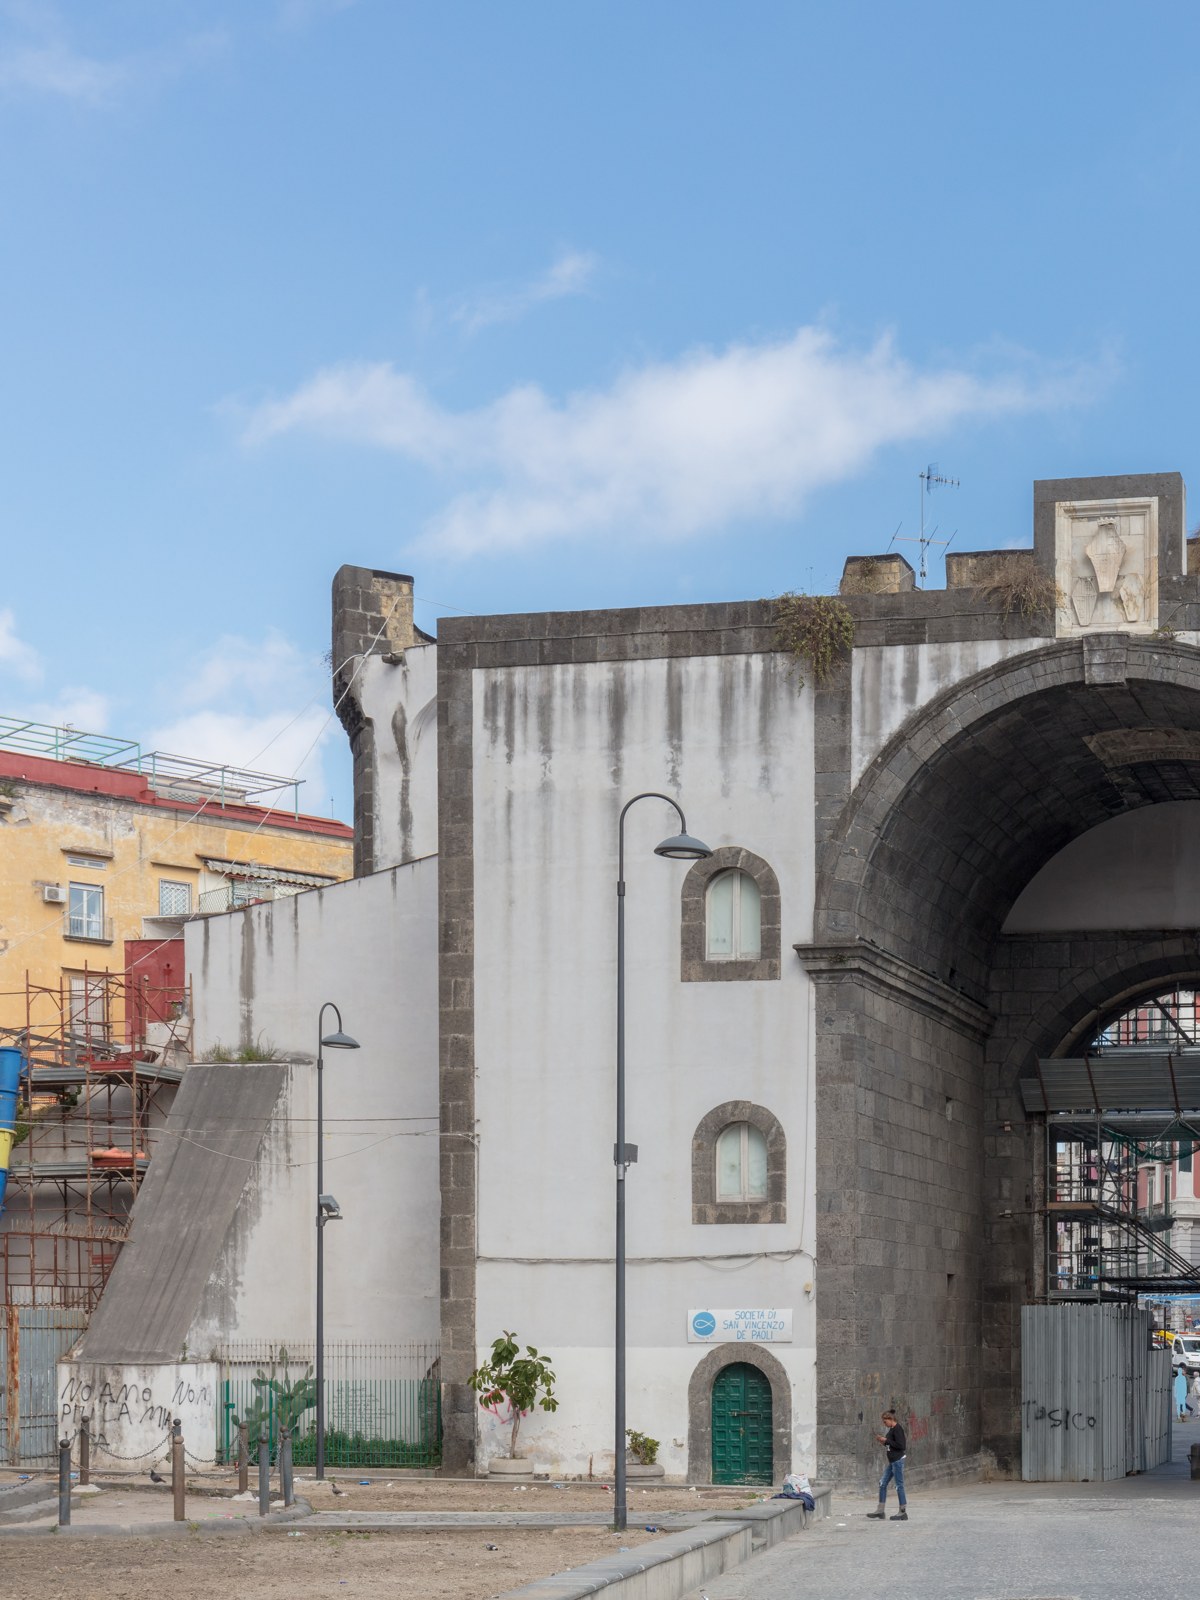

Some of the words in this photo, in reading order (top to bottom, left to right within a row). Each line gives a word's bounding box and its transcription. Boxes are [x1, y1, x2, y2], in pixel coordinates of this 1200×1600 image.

[768, 1310, 777, 1320] DI
[723, 1320, 739, 1330] SAN
[745, 1320, 785, 1330] VINCENZO
[736, 1330, 746, 1340] DE
[751, 1330, 773, 1340] PAOLI
